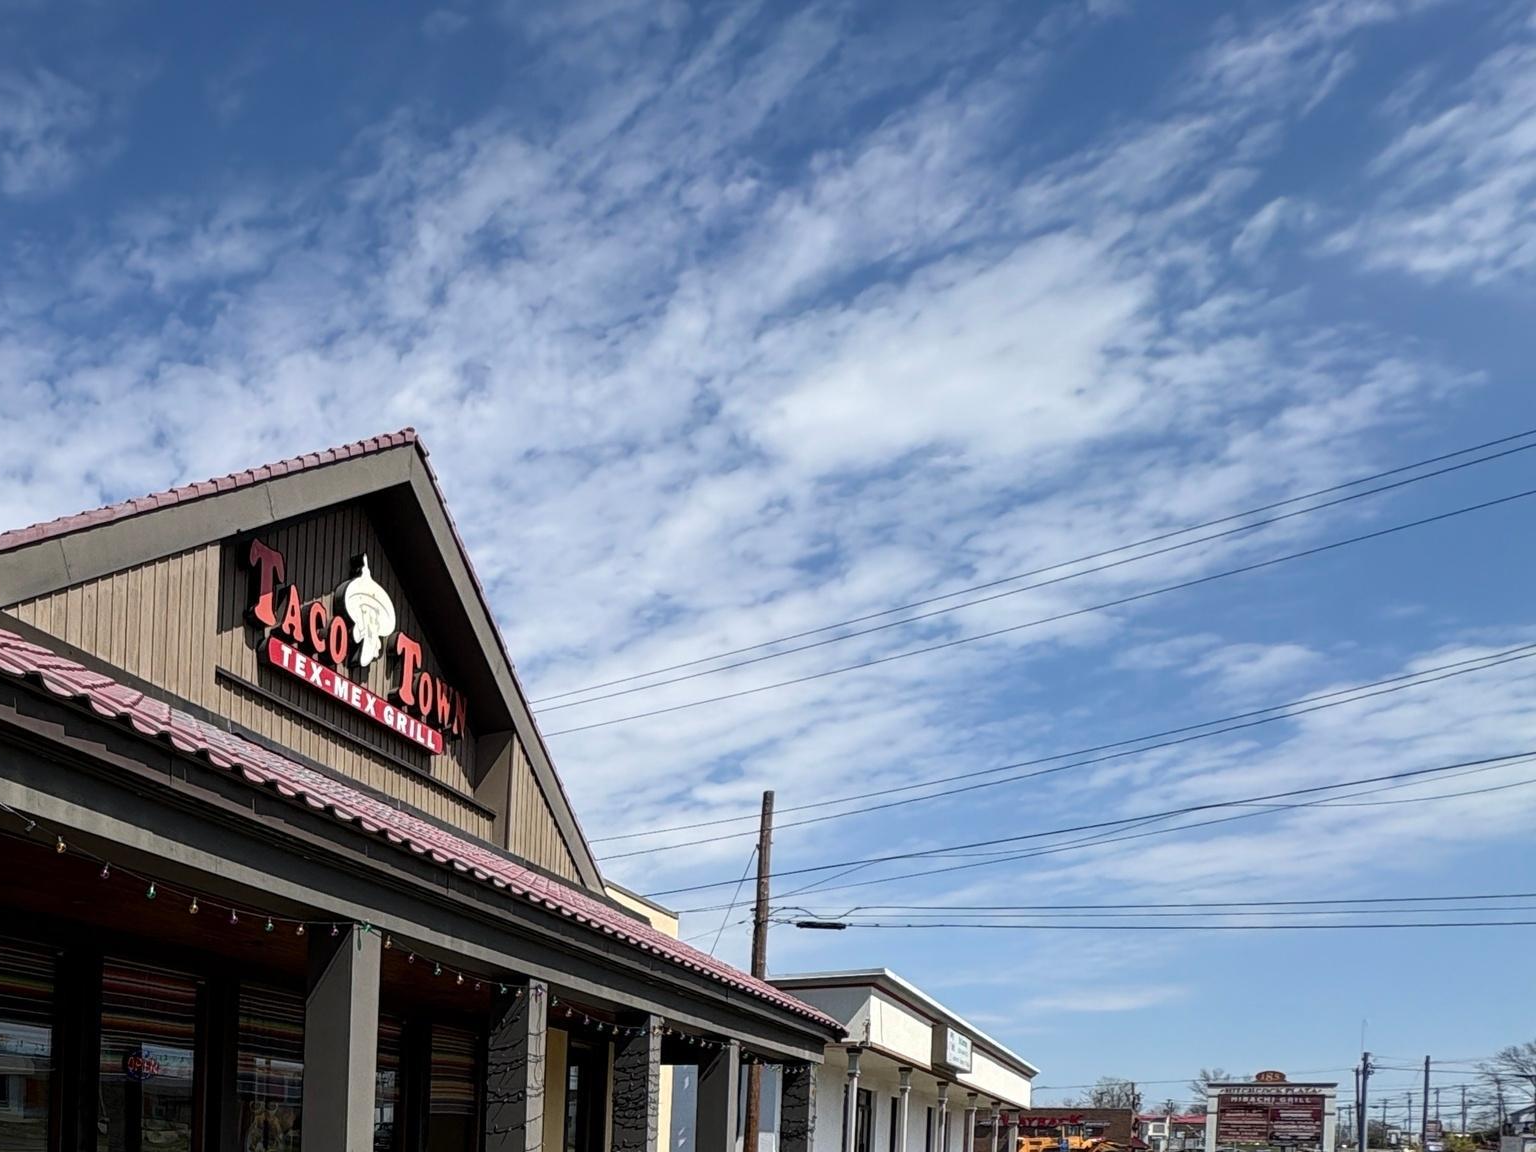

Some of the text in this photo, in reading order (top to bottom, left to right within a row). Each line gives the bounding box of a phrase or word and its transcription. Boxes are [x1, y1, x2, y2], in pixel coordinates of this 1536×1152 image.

[250, 538, 467, 737] TACO TOWN
[280, 643, 436, 750] TEX-MEX GRILL
[1230, 1096, 1312, 1104] HIBACHI GRILL
